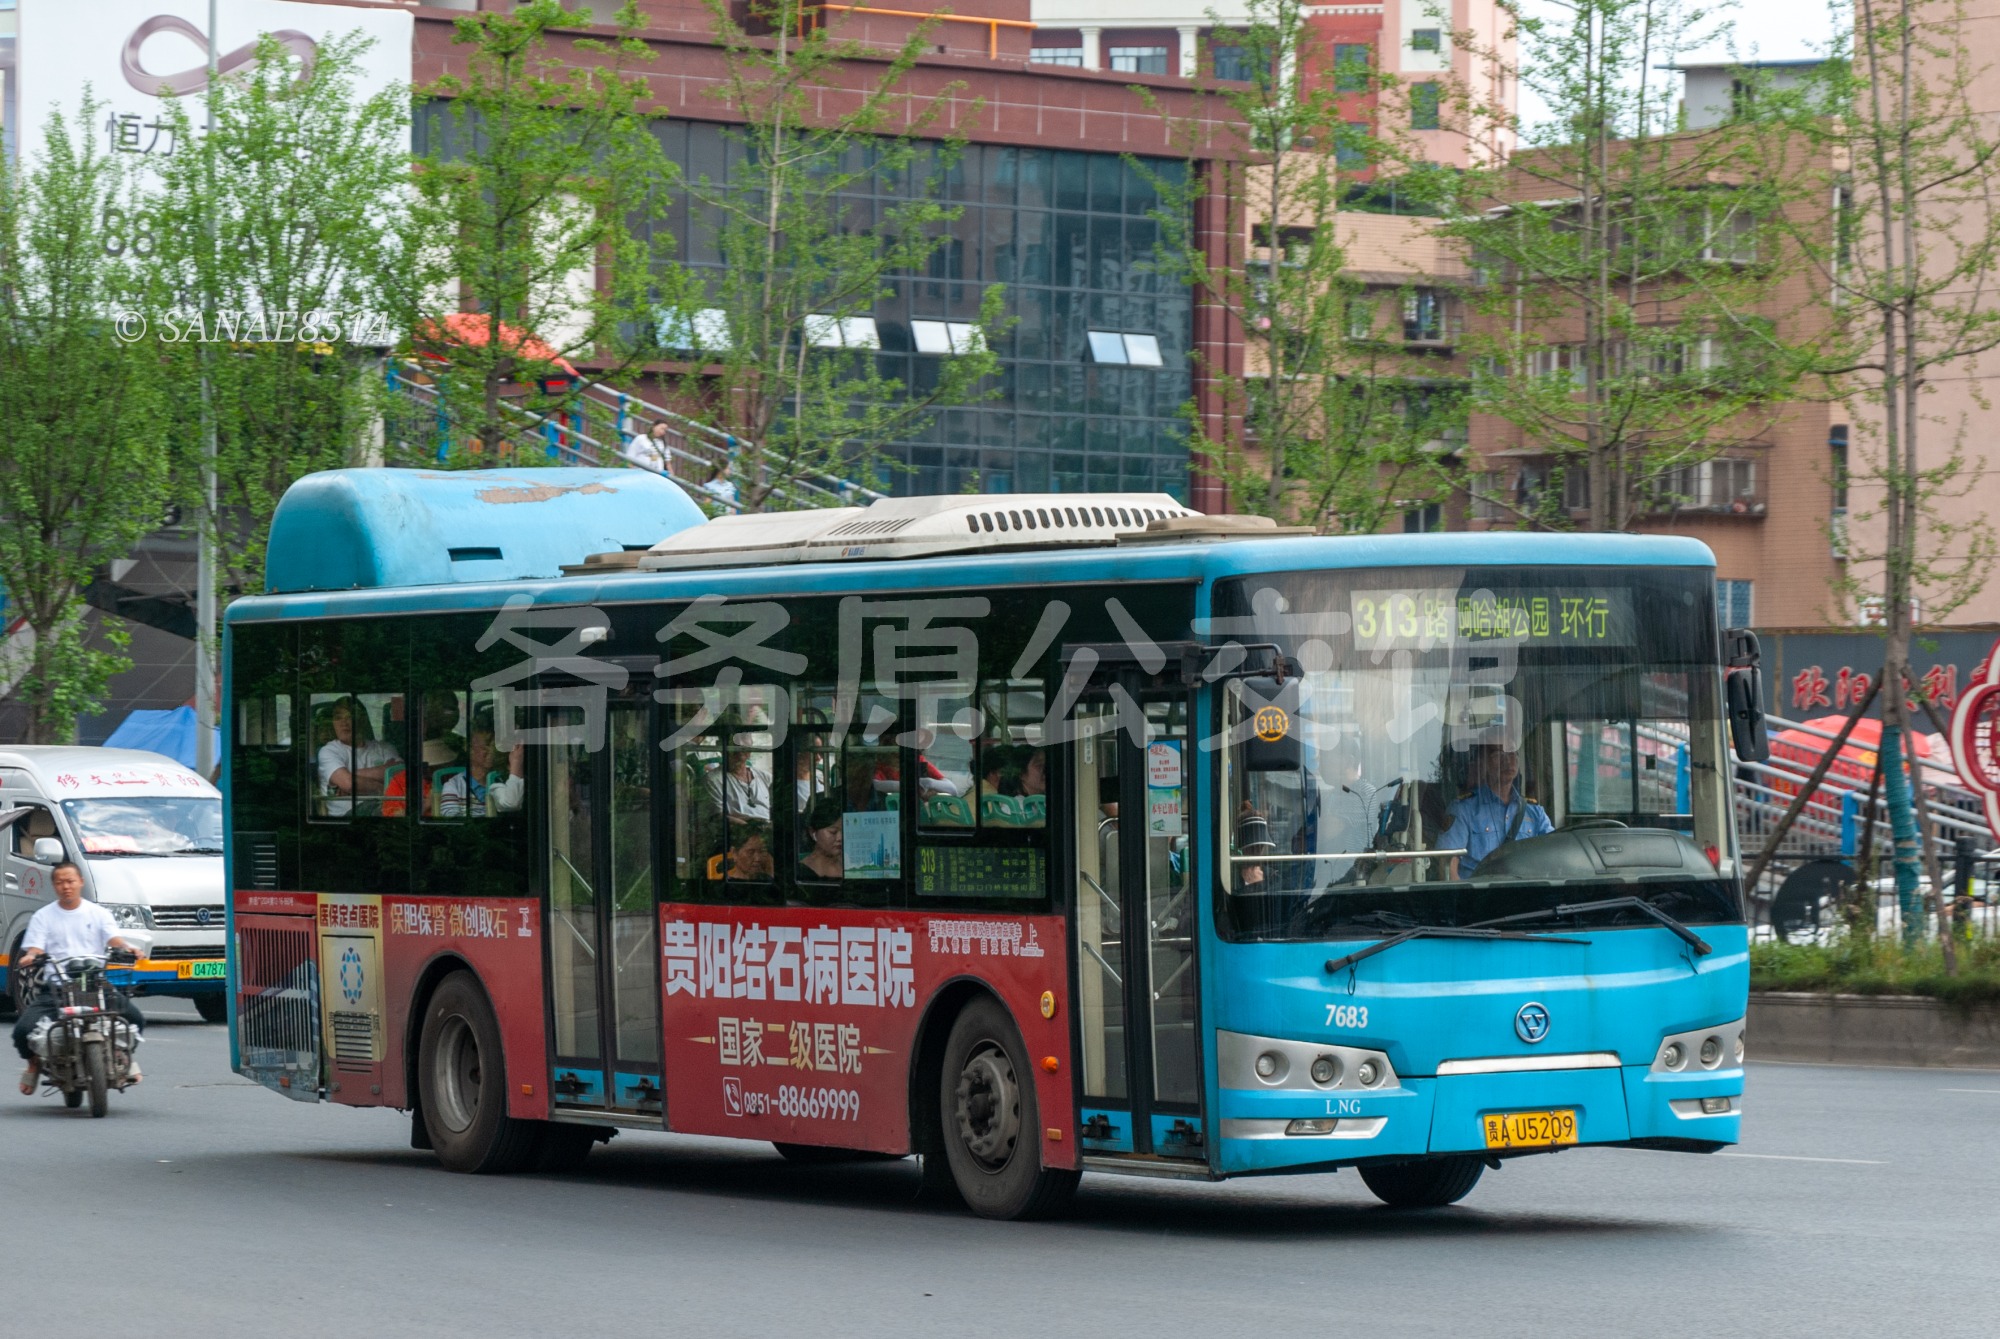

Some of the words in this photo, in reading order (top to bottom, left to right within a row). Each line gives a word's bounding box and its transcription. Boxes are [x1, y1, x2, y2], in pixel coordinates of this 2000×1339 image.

[1458, 597, 1549, 638] 阿哈湖公园
[1561, 597, 1609, 638] 环行
[1259, 714, 1283, 734] 313
[319, 903, 379, 928] 医保定点医院
[390, 903, 446, 936] 保胆保肾
[449, 904, 508, 939] 微创取石
[664, 920, 916, 1008] 贵阳结石病医院
[1325, 1004, 1368, 1029] 7683
[718, 1017, 863, 1075] 国家二级医院
[744, 1085, 860, 1122] 0851-88669999
[1325, 1098, 1362, 1116] LNG
